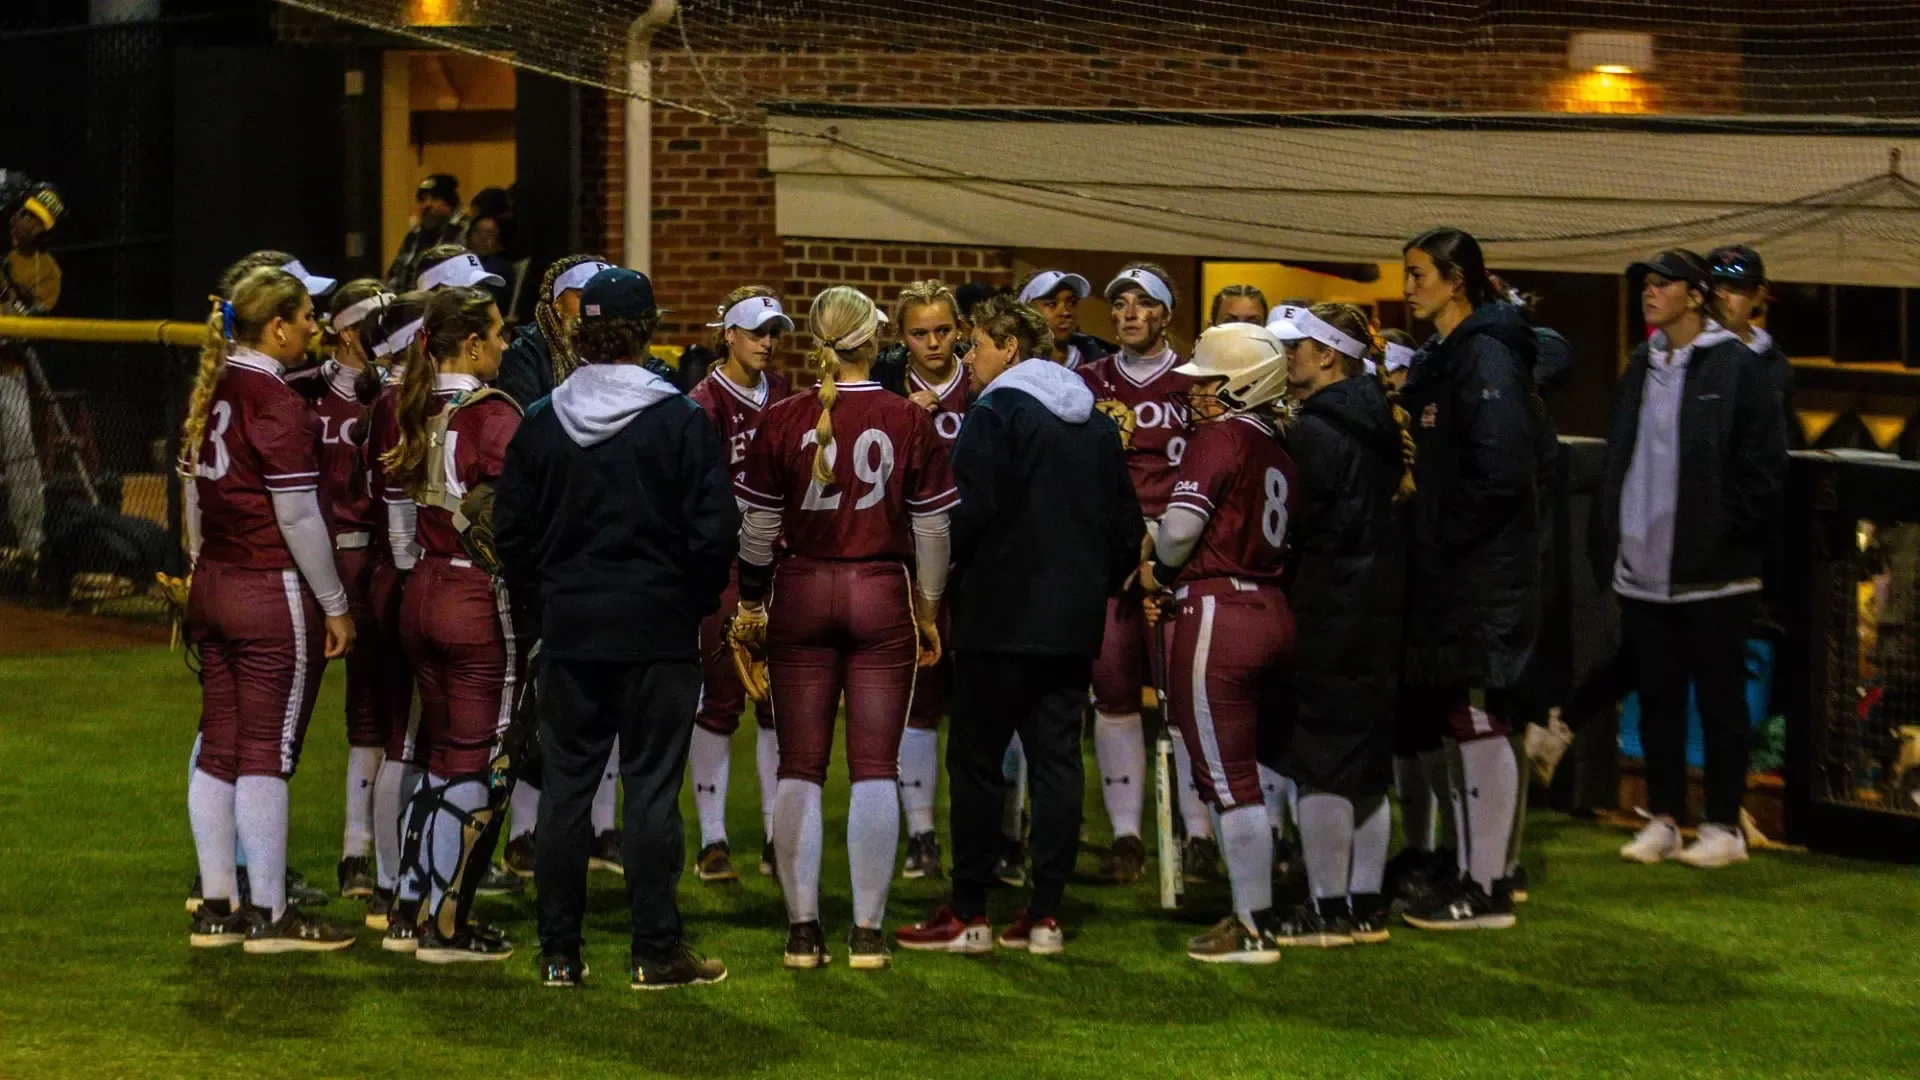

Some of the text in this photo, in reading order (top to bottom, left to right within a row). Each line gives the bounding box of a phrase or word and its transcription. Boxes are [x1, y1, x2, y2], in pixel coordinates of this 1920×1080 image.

[467, 255, 478, 266] E
[762, 298, 773, 307] E
[1284, 308, 1295, 318] E
[934, 411, 965, 439] O
[728, 428, 757, 465] E
[1166, 436, 1186, 466] 9
[800, 428, 895, 511] 29
[1173, 480, 1199, 492] CAA
[1262, 467, 1288, 548] 8
